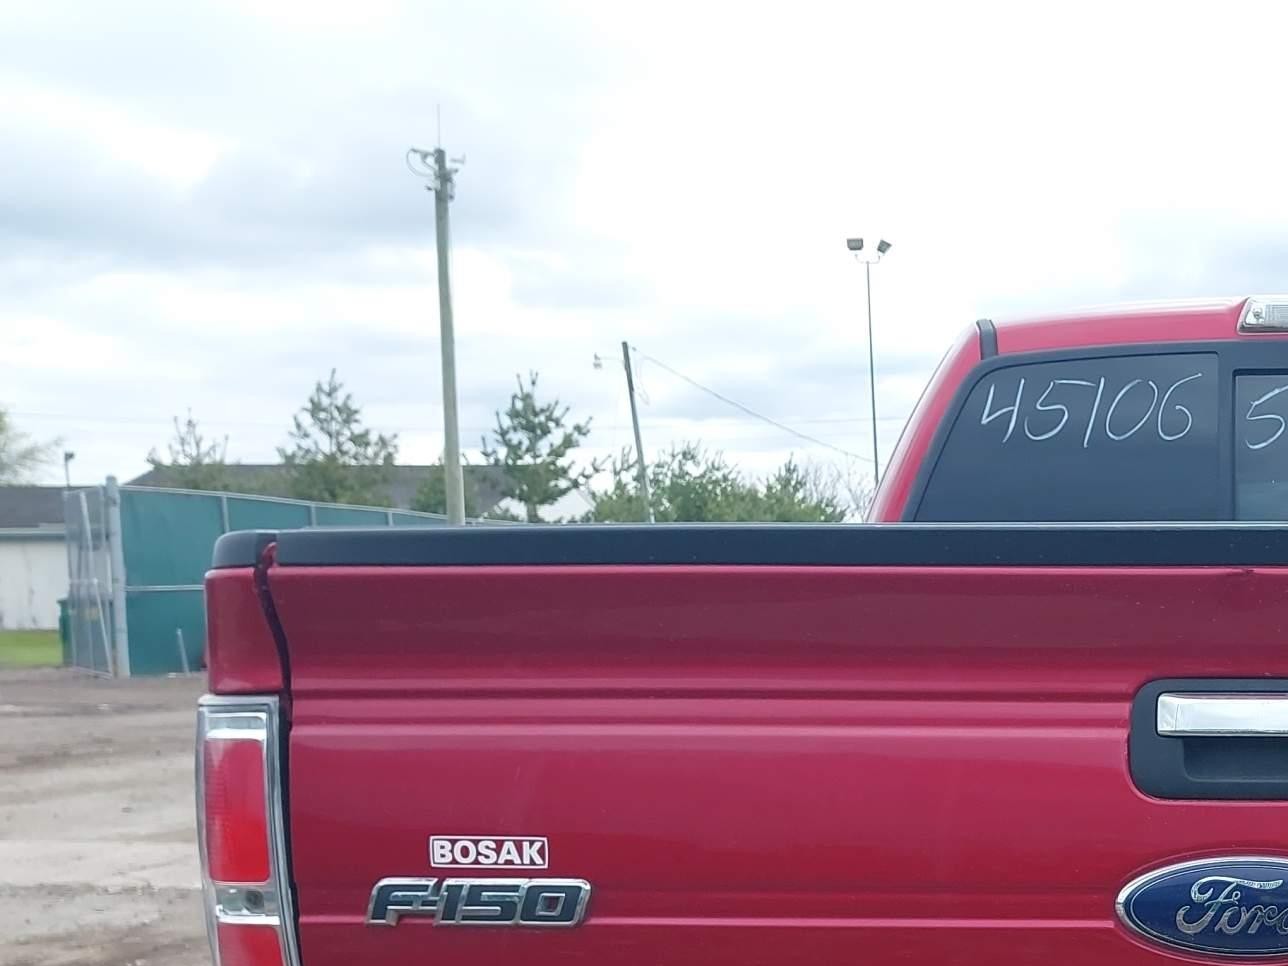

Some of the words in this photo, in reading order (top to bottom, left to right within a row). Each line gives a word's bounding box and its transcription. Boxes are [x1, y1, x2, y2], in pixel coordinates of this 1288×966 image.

[979, 372, 1203, 449] 45106
[432, 840, 544, 864] BOSAK
[365, 877, 591, 926] F-150
